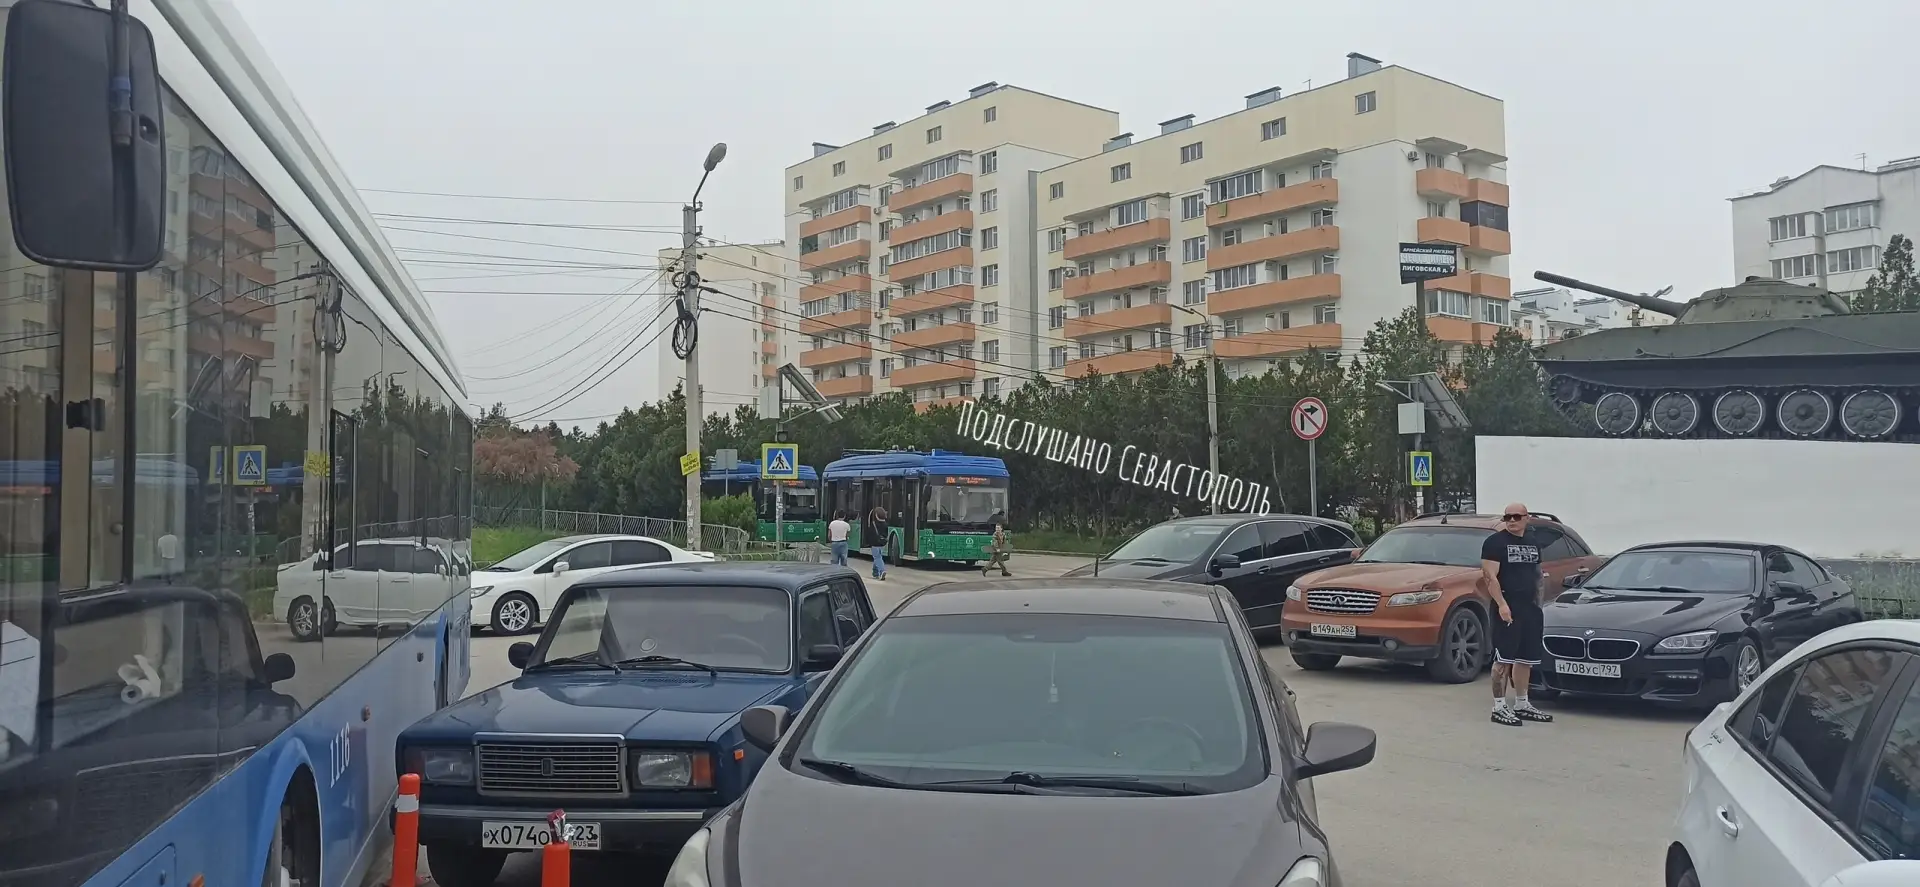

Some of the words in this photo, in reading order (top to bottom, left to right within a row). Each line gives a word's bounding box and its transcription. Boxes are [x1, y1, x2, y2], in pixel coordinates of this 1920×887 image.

[1402, 265, 1441, 273] ЛИГОВСКАЯ
[1450, 265, 1455, 273] 7
[1341, 625, 1354, 633] 252
[1559, 662, 1599, 675] Н708УС
[1600, 665, 1618, 673] 797
[330, 722, 350, 788] 1116
